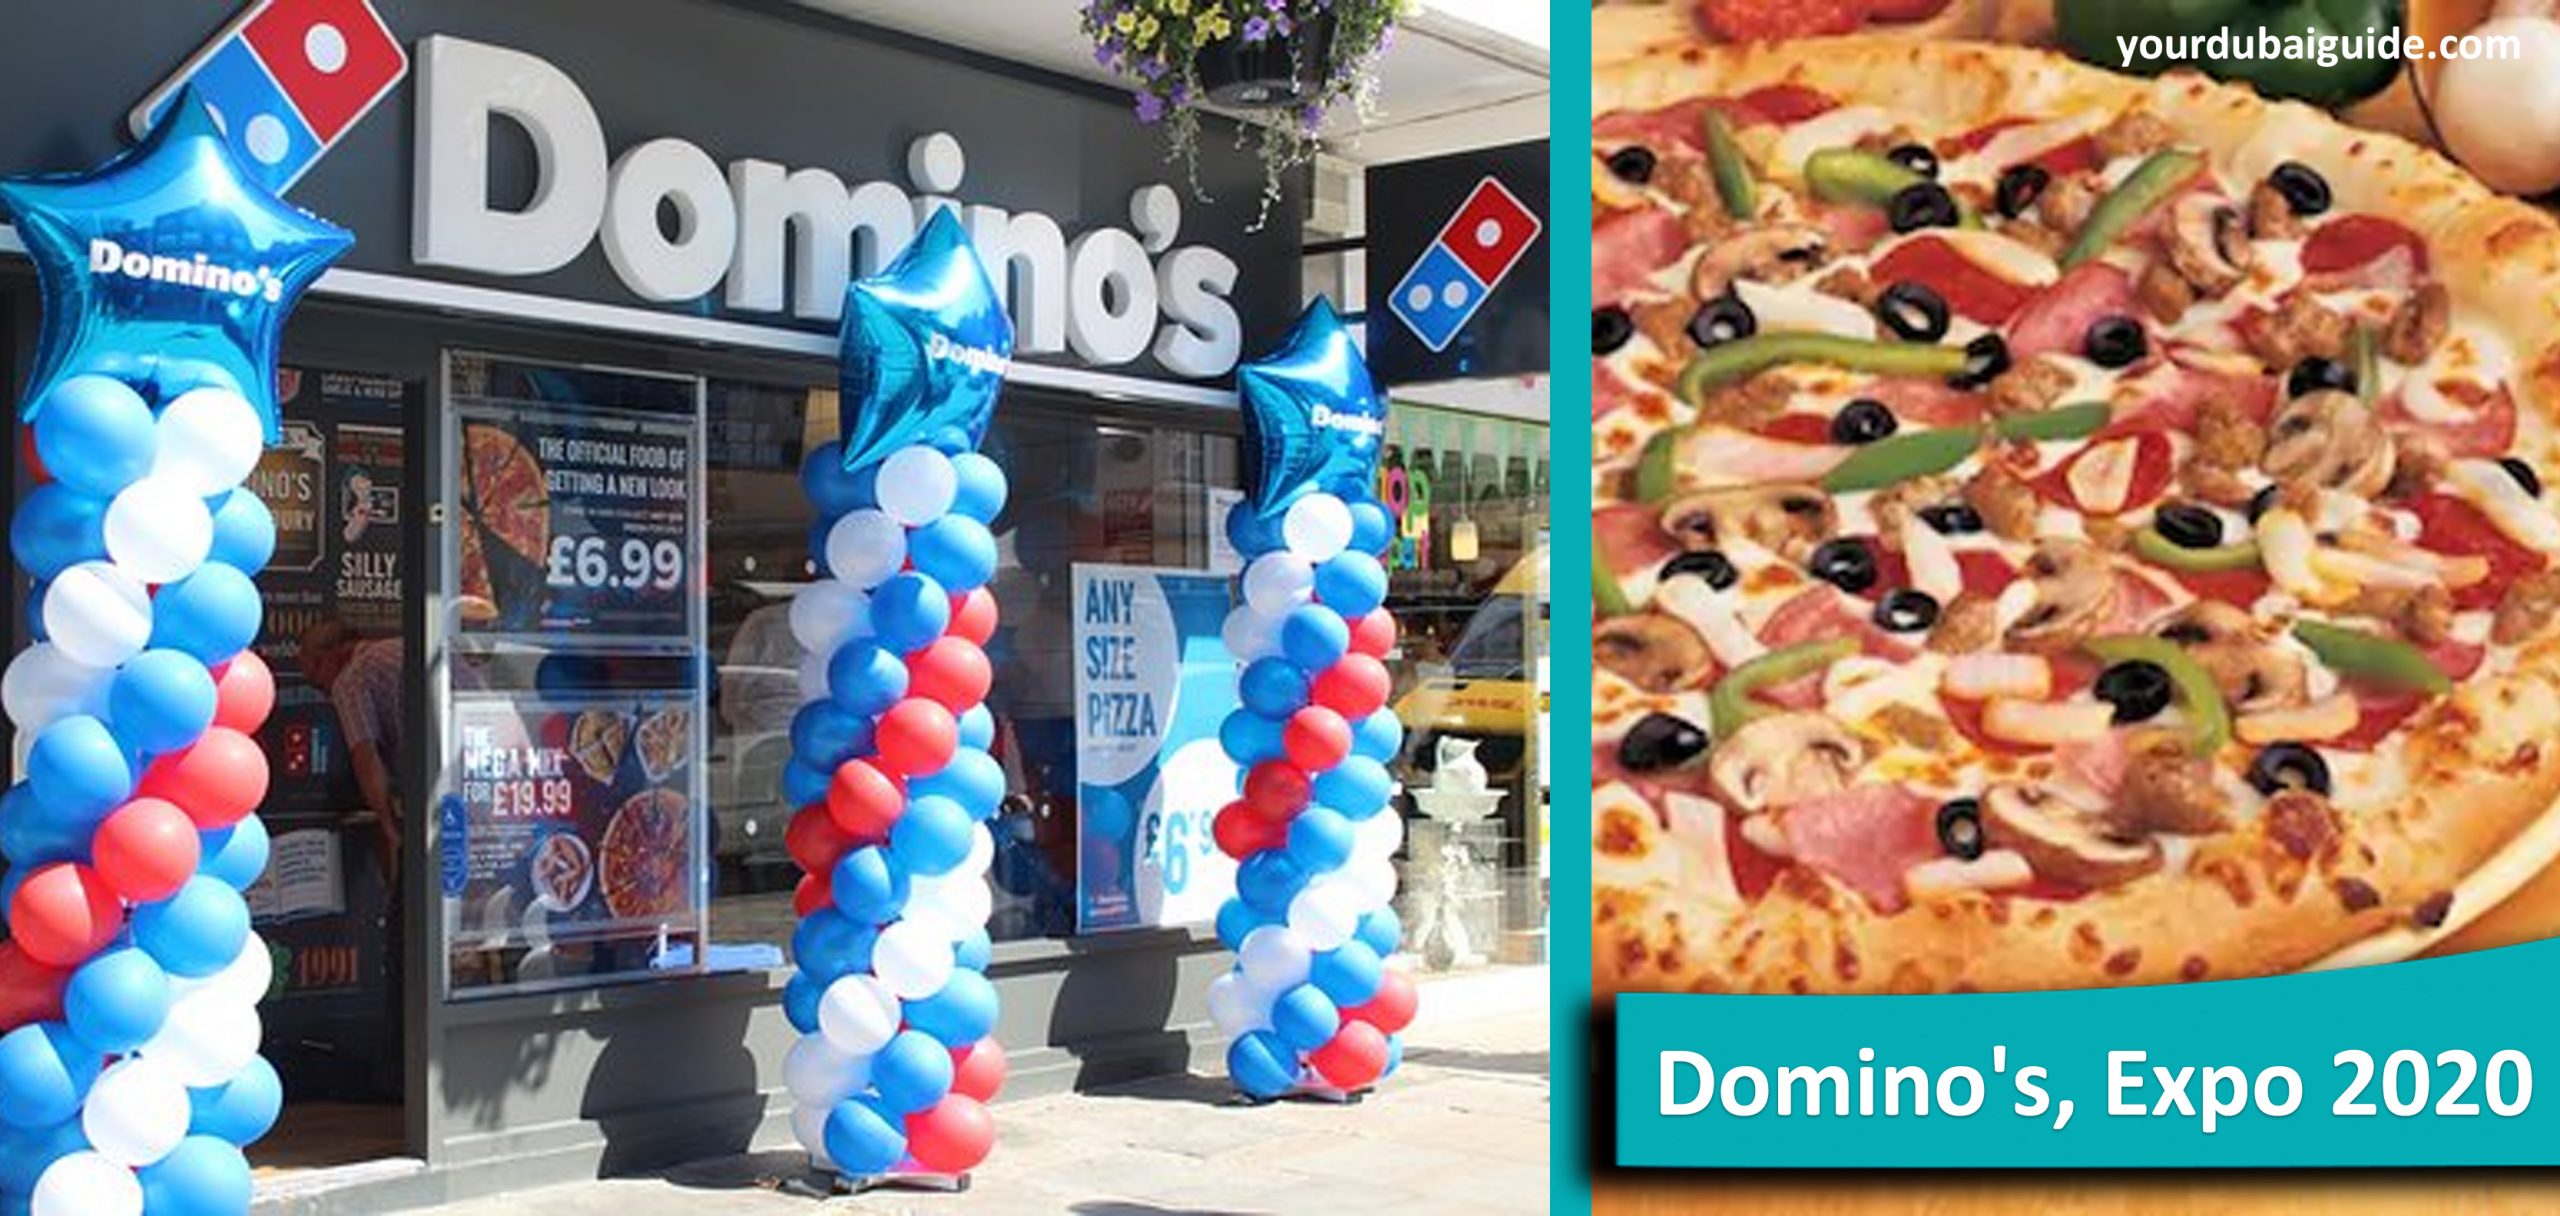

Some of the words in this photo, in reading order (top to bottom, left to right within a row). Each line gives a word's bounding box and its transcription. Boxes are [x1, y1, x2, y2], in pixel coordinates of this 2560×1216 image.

[89, 237, 284, 303] Domino's
[539, 437, 564, 461] THE
[567, 440, 627, 465] OFFICIAL
[630, 446, 667, 468] FOOD
[669, 450, 686, 470] OF
[545, 470, 604, 494] GETTING
[606, 474, 617, 495] A
[619, 476, 647, 497] NEW
[341, 552, 396, 577] SILLY
[546, 535, 683, 590] £6.99
[336, 579, 402, 600] SAUSAGE
[1085, 577, 1135, 624] ANY
[1086, 635, 1137, 681] SIZE
[1088, 692, 1157, 737] PIZZA
[463, 725, 493, 747] THE
[463, 748, 521, 778] MEGA
[463, 781, 491, 803] FOR
[493, 779, 572, 816] £19.99
[299, 946, 358, 986] 1991
